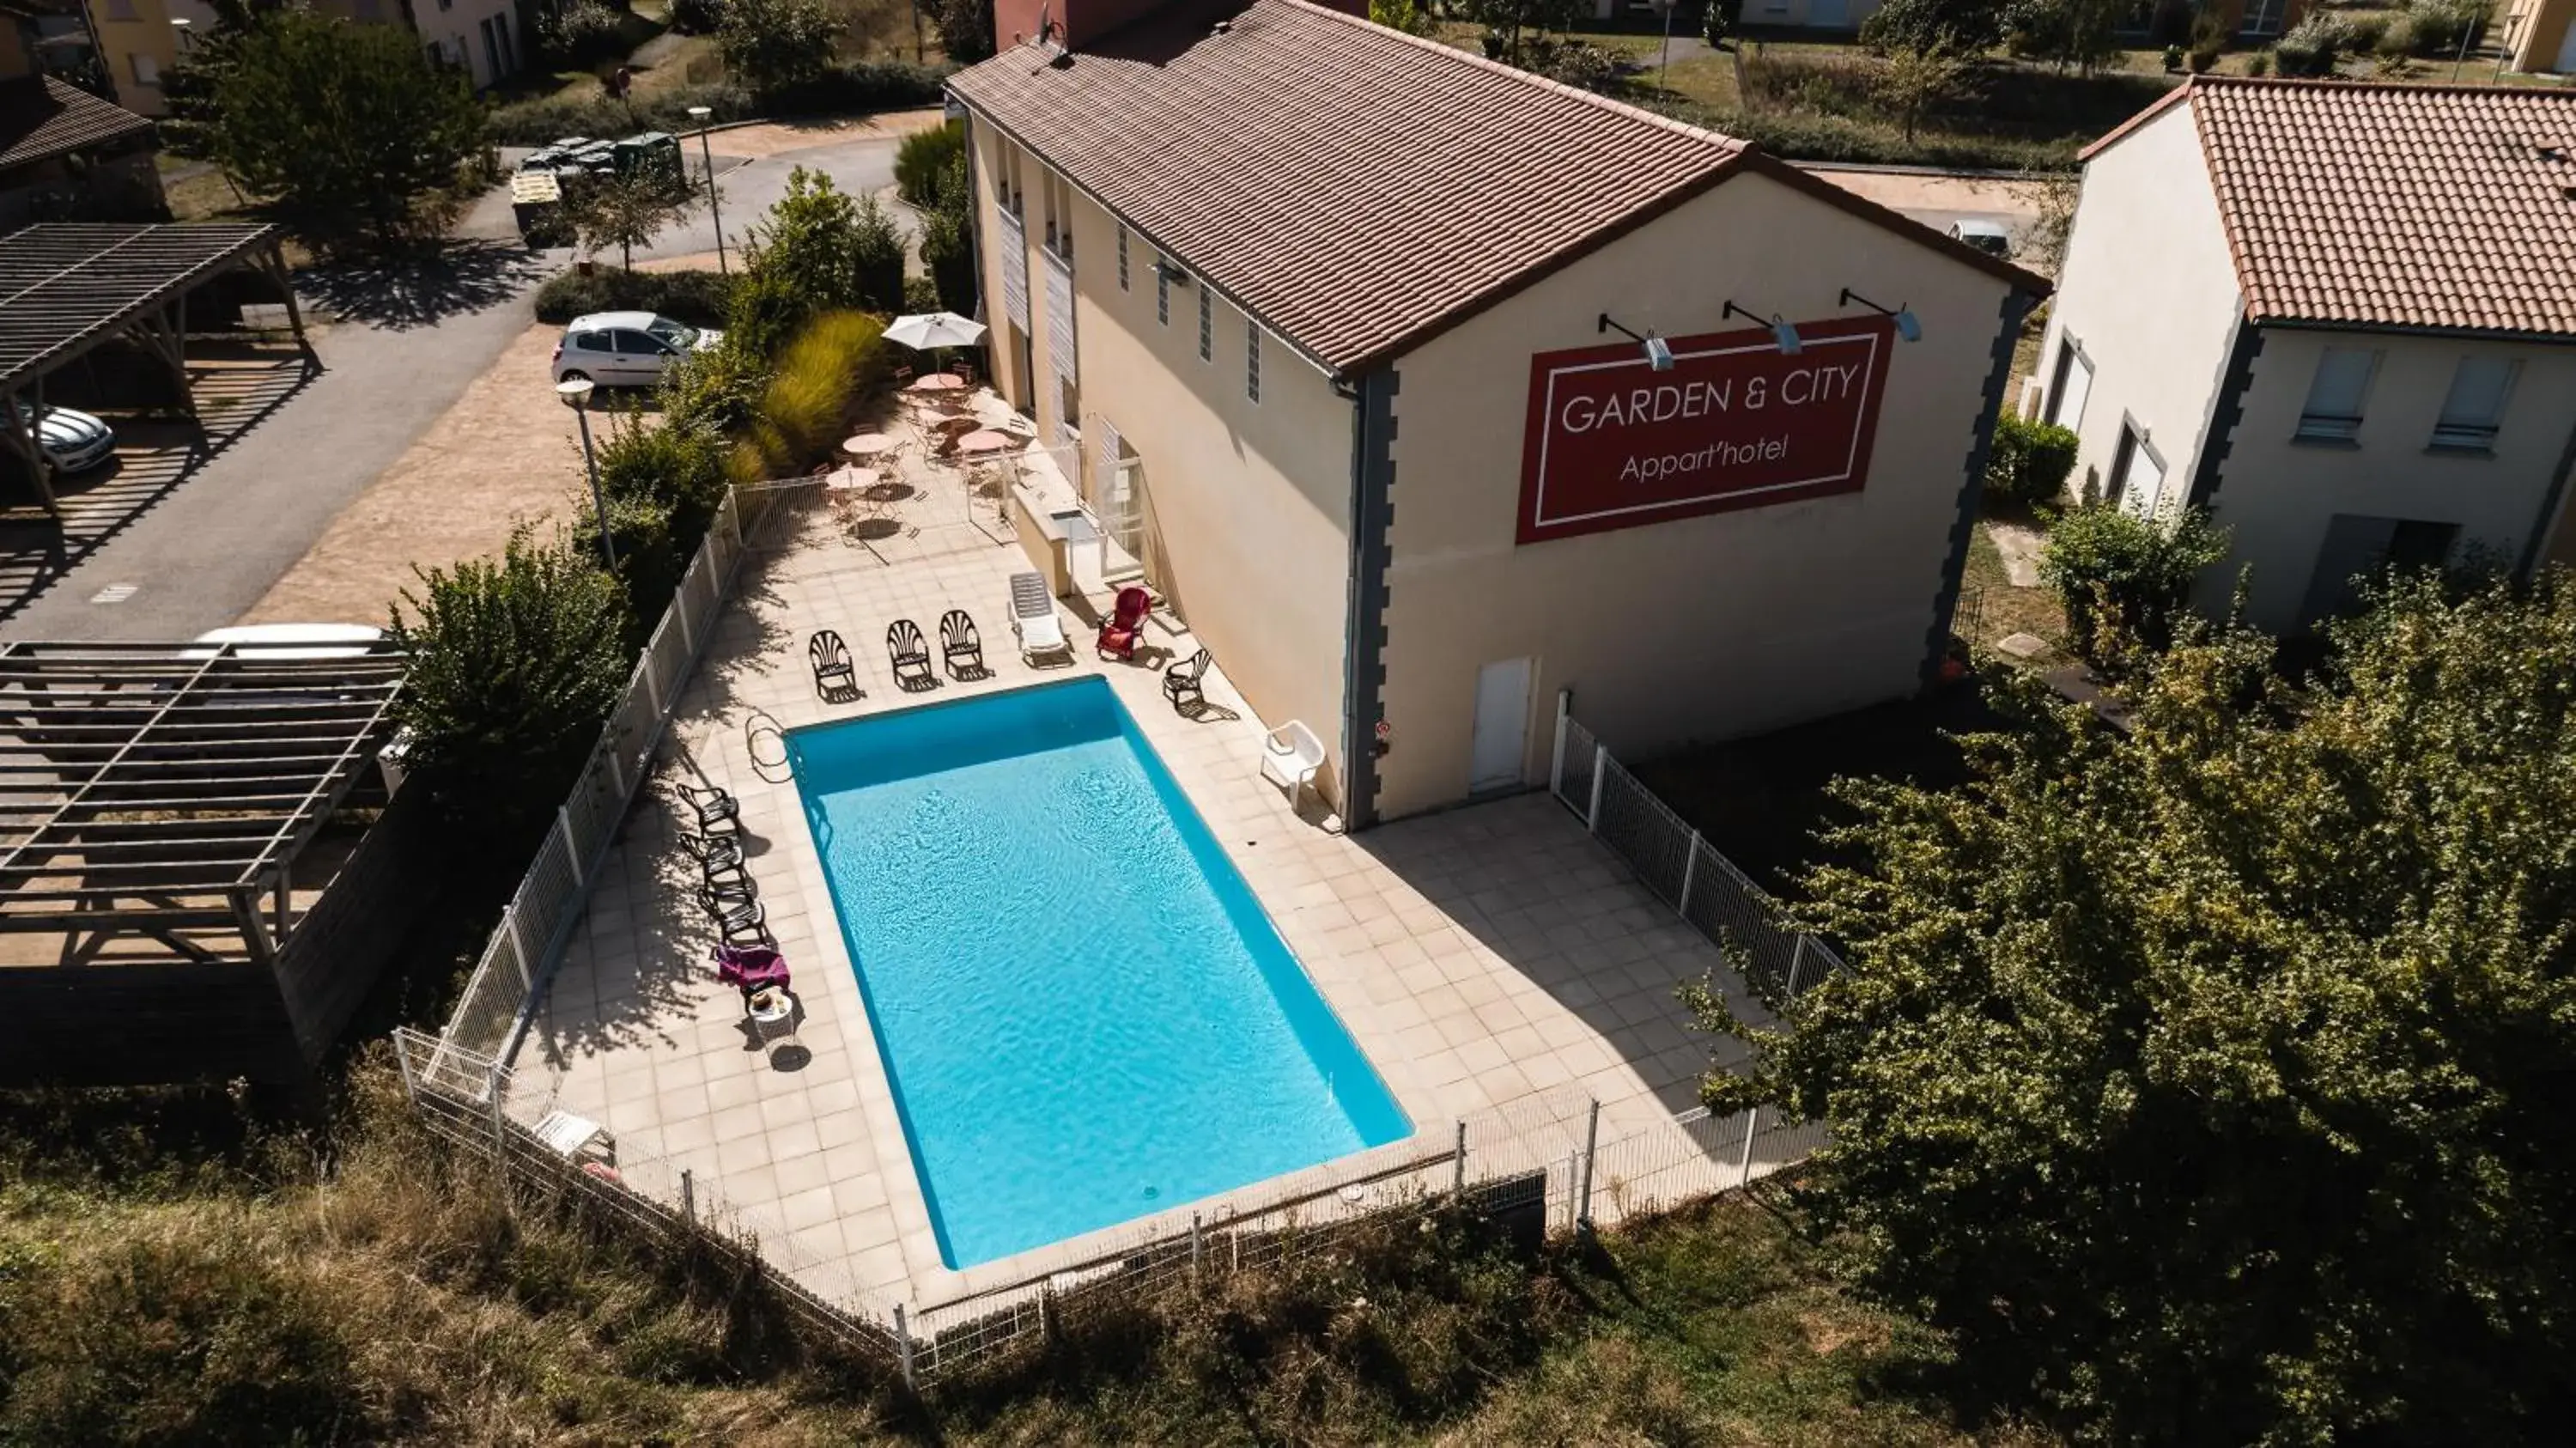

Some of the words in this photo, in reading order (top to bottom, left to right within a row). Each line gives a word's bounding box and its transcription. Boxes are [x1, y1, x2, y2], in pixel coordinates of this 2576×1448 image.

[1562, 379, 1731, 433] GARDEN
[1745, 376, 1765, 409] &
[1782, 364, 1860, 405] CITY
[1620, 435, 1789, 483] Appart'hotel
